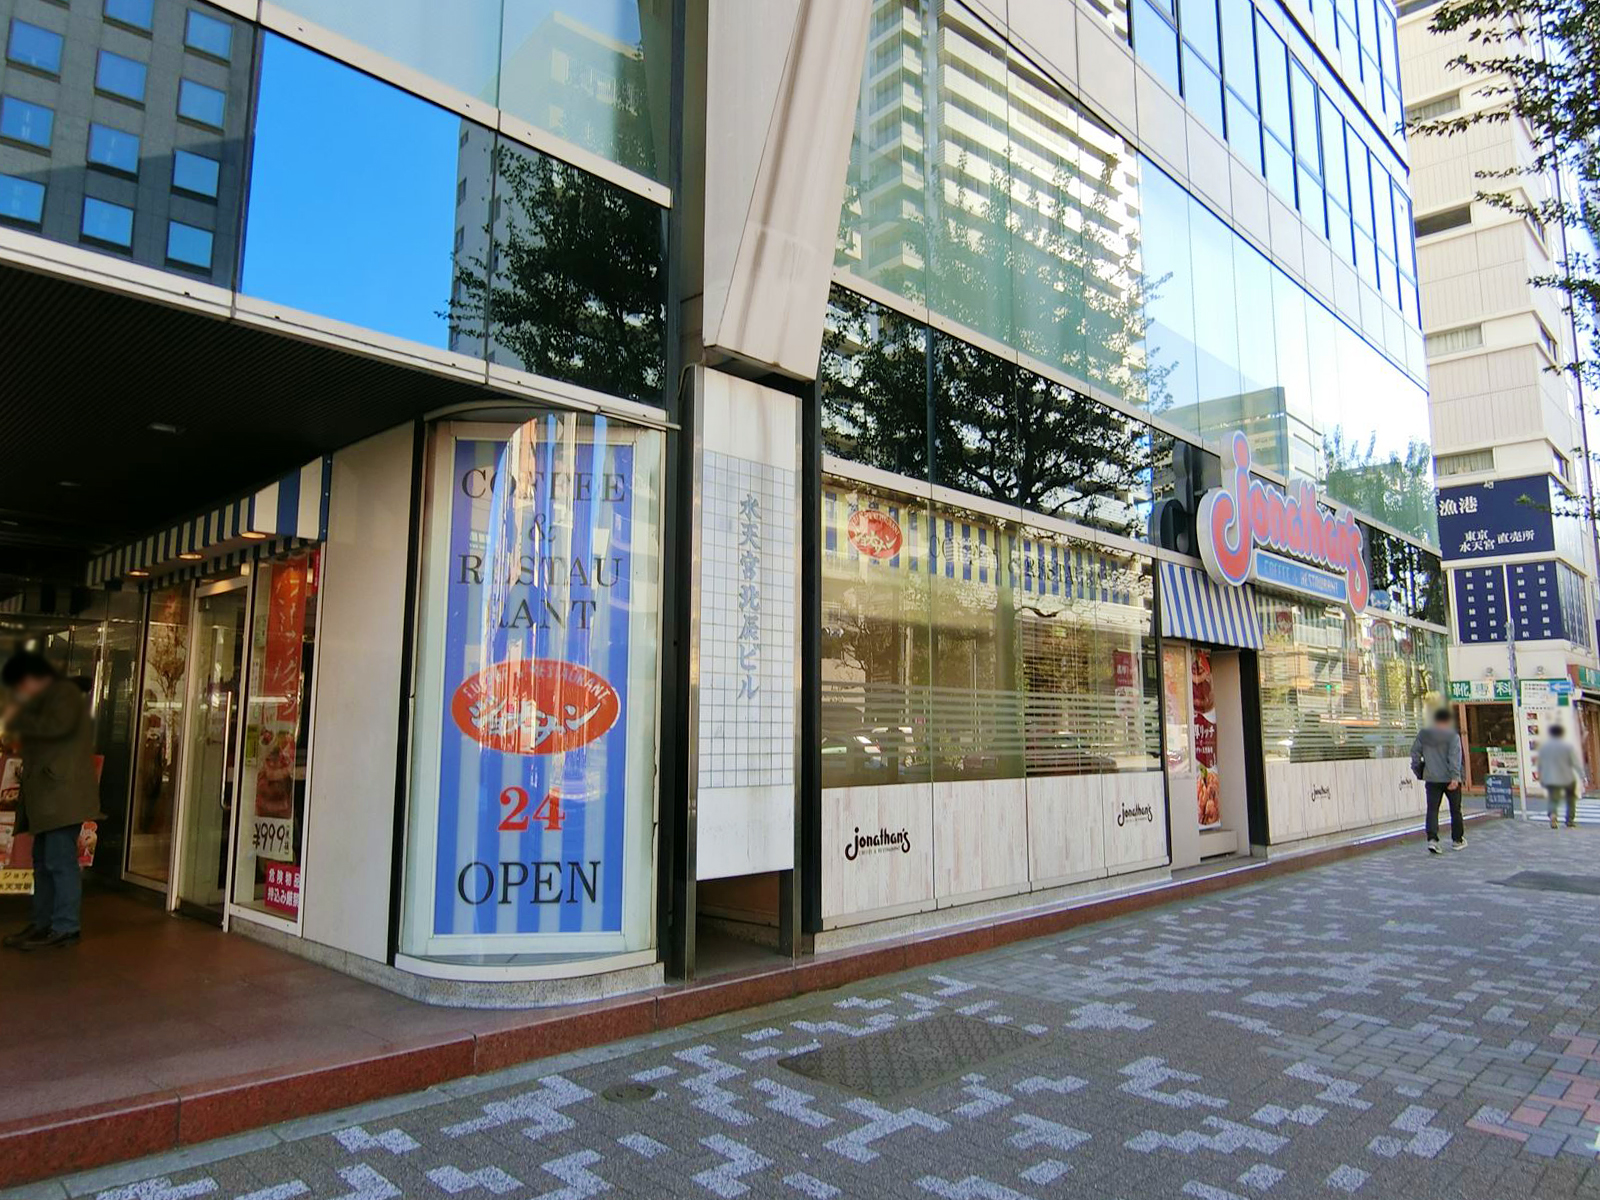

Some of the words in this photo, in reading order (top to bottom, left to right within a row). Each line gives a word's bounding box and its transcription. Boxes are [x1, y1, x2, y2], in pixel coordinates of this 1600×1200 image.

[1210, 430, 1368, 614] jonathan's
[1438, 495, 1478, 517] 漁港
[1459, 539, 1496, 553] 水天宮
[1464, 529, 1489, 542] 東京
[1497, 529, 1535, 545] 直売所
[457, 555, 623, 588] RSTAU
[737, 493, 761, 701] 水天宮北辰ビル
[486, 598, 597, 630] ANT
[498, 785, 567, 833] 24
[1117, 802, 1153, 827] jonathan's
[252, 822, 286, 853] ¥999
[845, 826, 911, 861] jonathan's
[457, 859, 602, 908] OPEN
